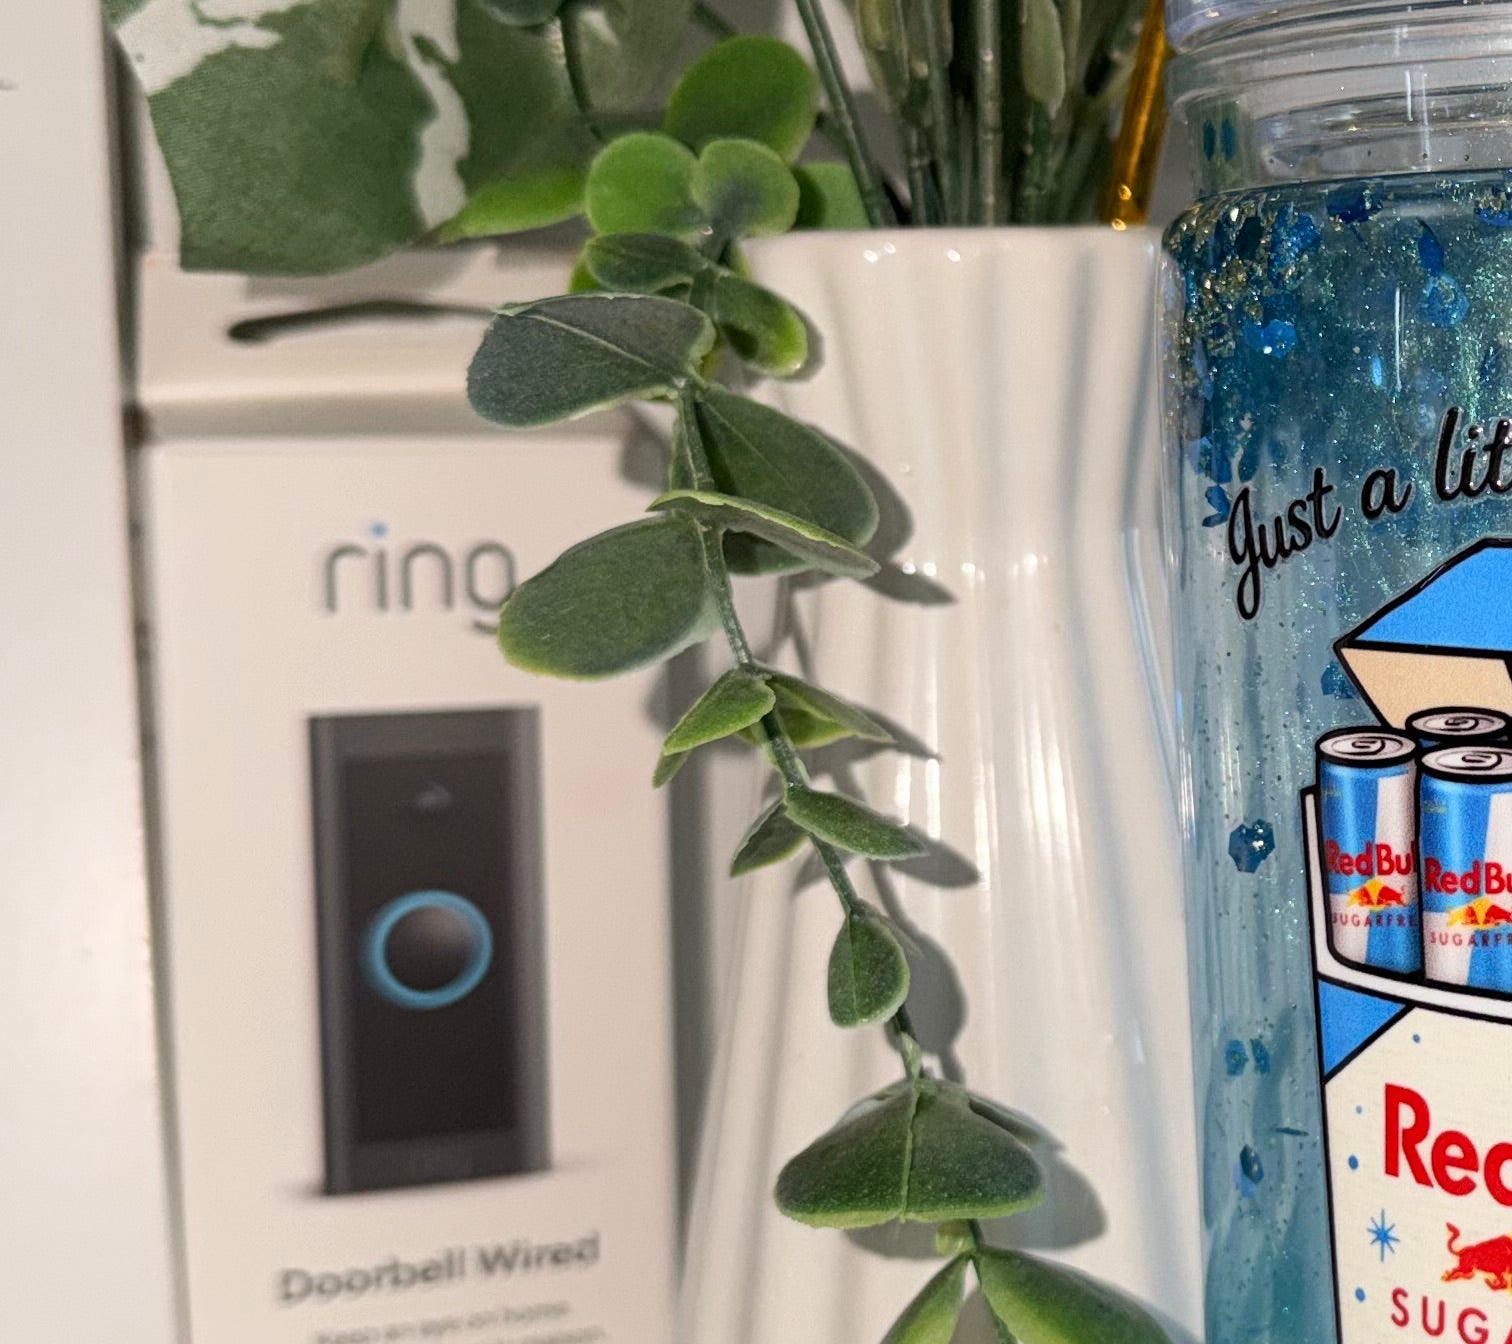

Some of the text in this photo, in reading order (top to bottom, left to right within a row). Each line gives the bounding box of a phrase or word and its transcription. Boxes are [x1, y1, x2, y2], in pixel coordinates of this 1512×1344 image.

[324, 520, 516, 635] ring
[1227, 468, 1344, 618] Just
[1360, 467, 1412, 515] a
[1425, 857, 1479, 894] Red
[280, 1228, 601, 1304] Doorbell Wired
